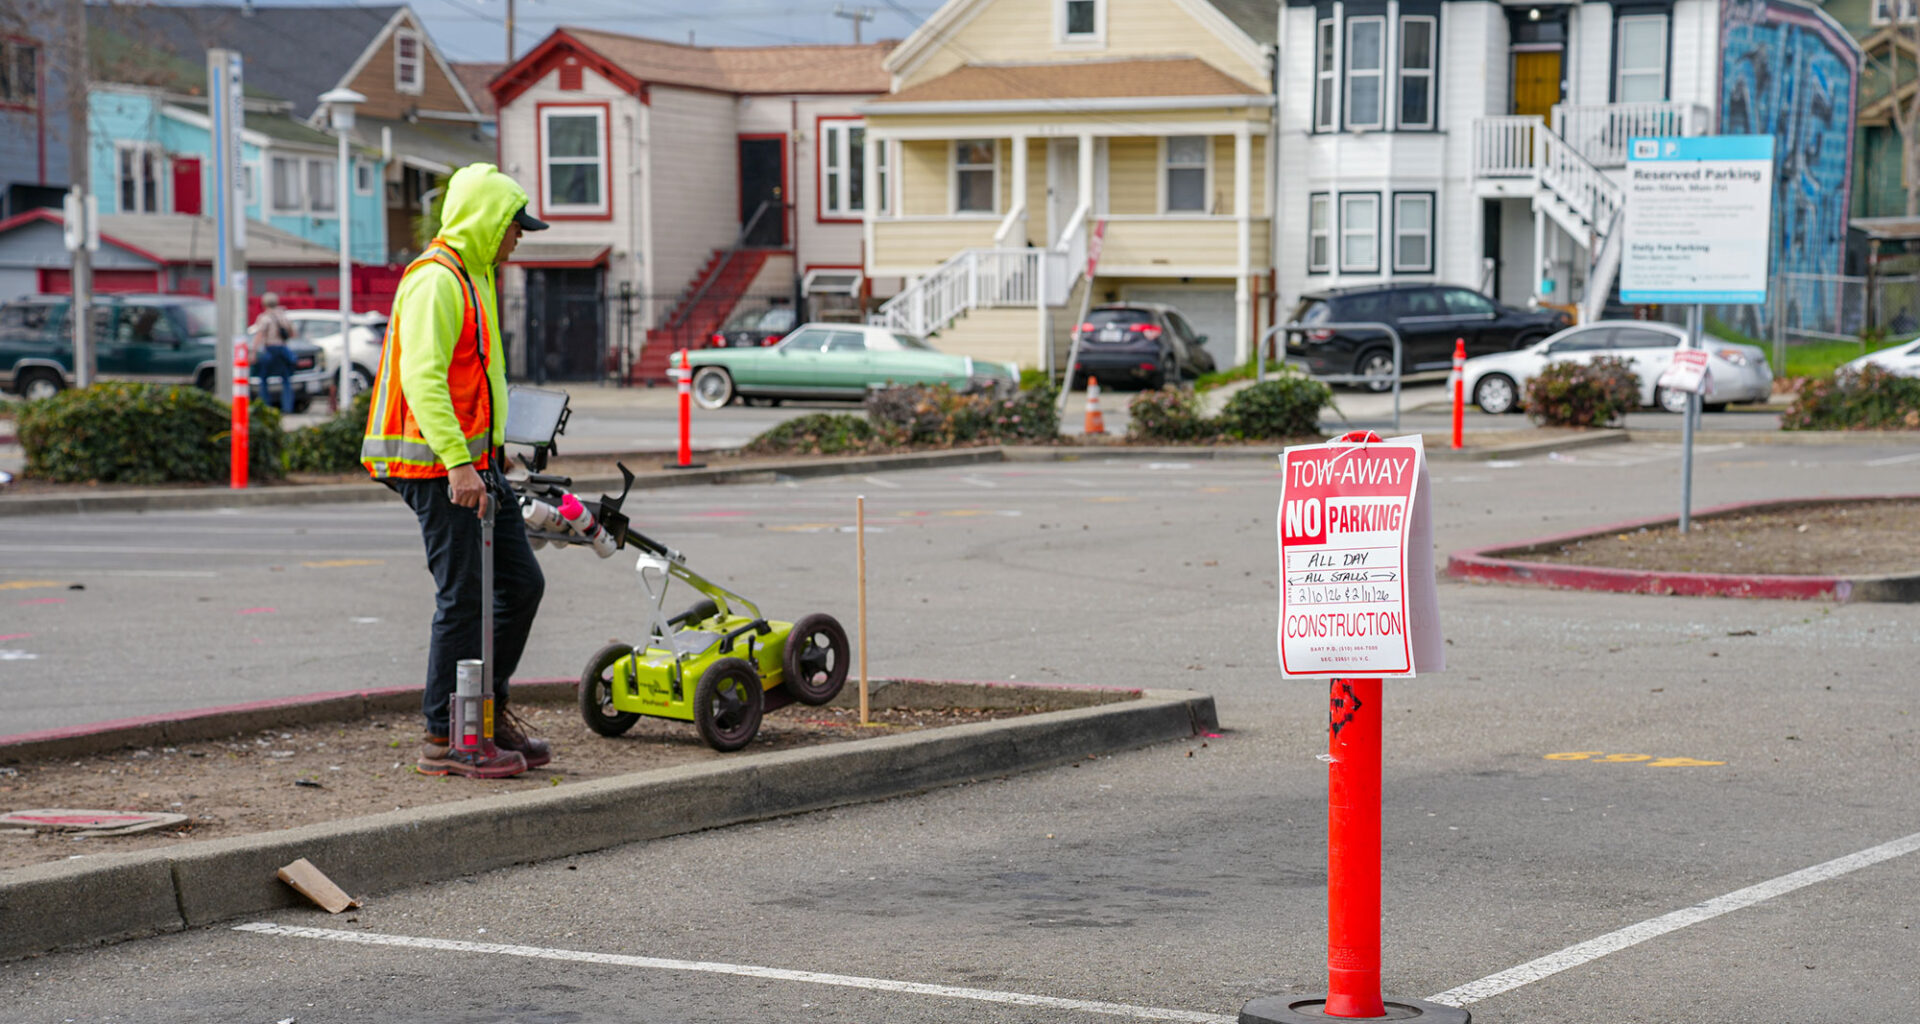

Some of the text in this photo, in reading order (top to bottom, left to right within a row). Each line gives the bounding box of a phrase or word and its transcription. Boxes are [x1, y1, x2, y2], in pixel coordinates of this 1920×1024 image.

[1634, 168, 1761, 183] Reserved Parking
[1291, 458, 1409, 488] TOW-AWAY
[1285, 498, 1401, 538] NO PARKING
[1308, 552, 1369, 567] ALL DAY
[1305, 571, 1368, 582] ALL STALLS
[1287, 611, 1401, 638] CONSTRUCTION
